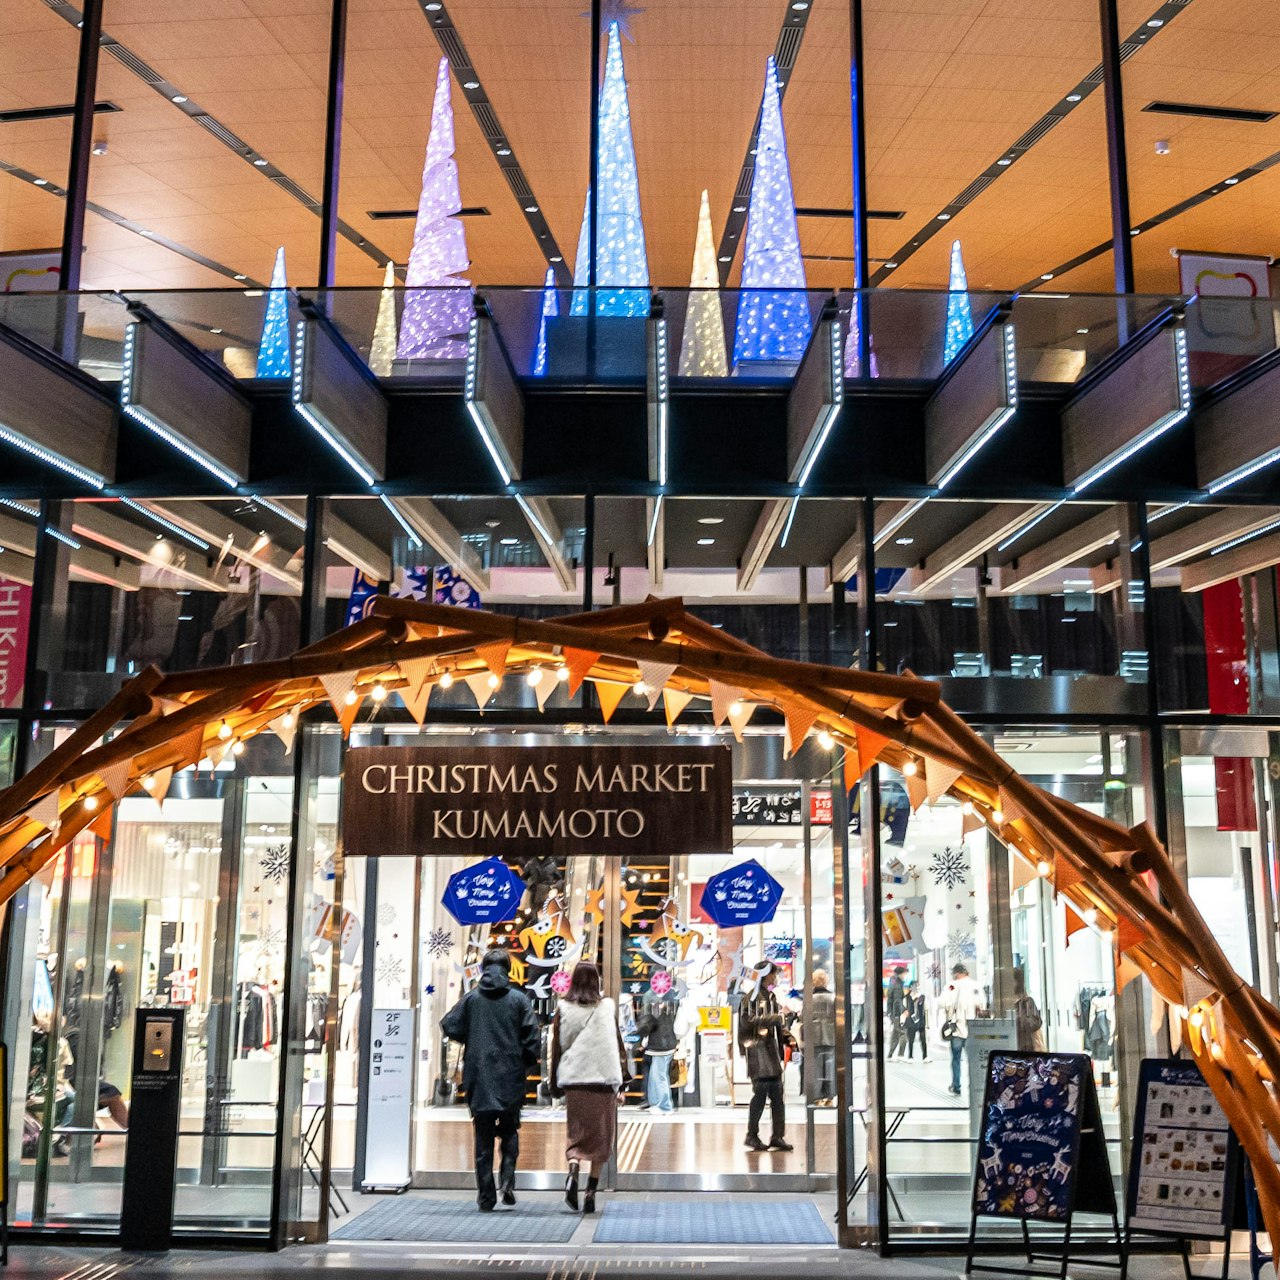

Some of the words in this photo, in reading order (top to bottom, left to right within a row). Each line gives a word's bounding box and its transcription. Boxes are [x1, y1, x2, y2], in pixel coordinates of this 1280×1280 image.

[361, 764, 558, 794] CHRISTMAS
[573, 763, 714, 793] MARKET
[432, 809, 645, 840] KUMAMOTO
[472, 873, 496, 888] Very
[731, 875, 755, 890] Very
[386, 1013, 400, 1022] 2F
